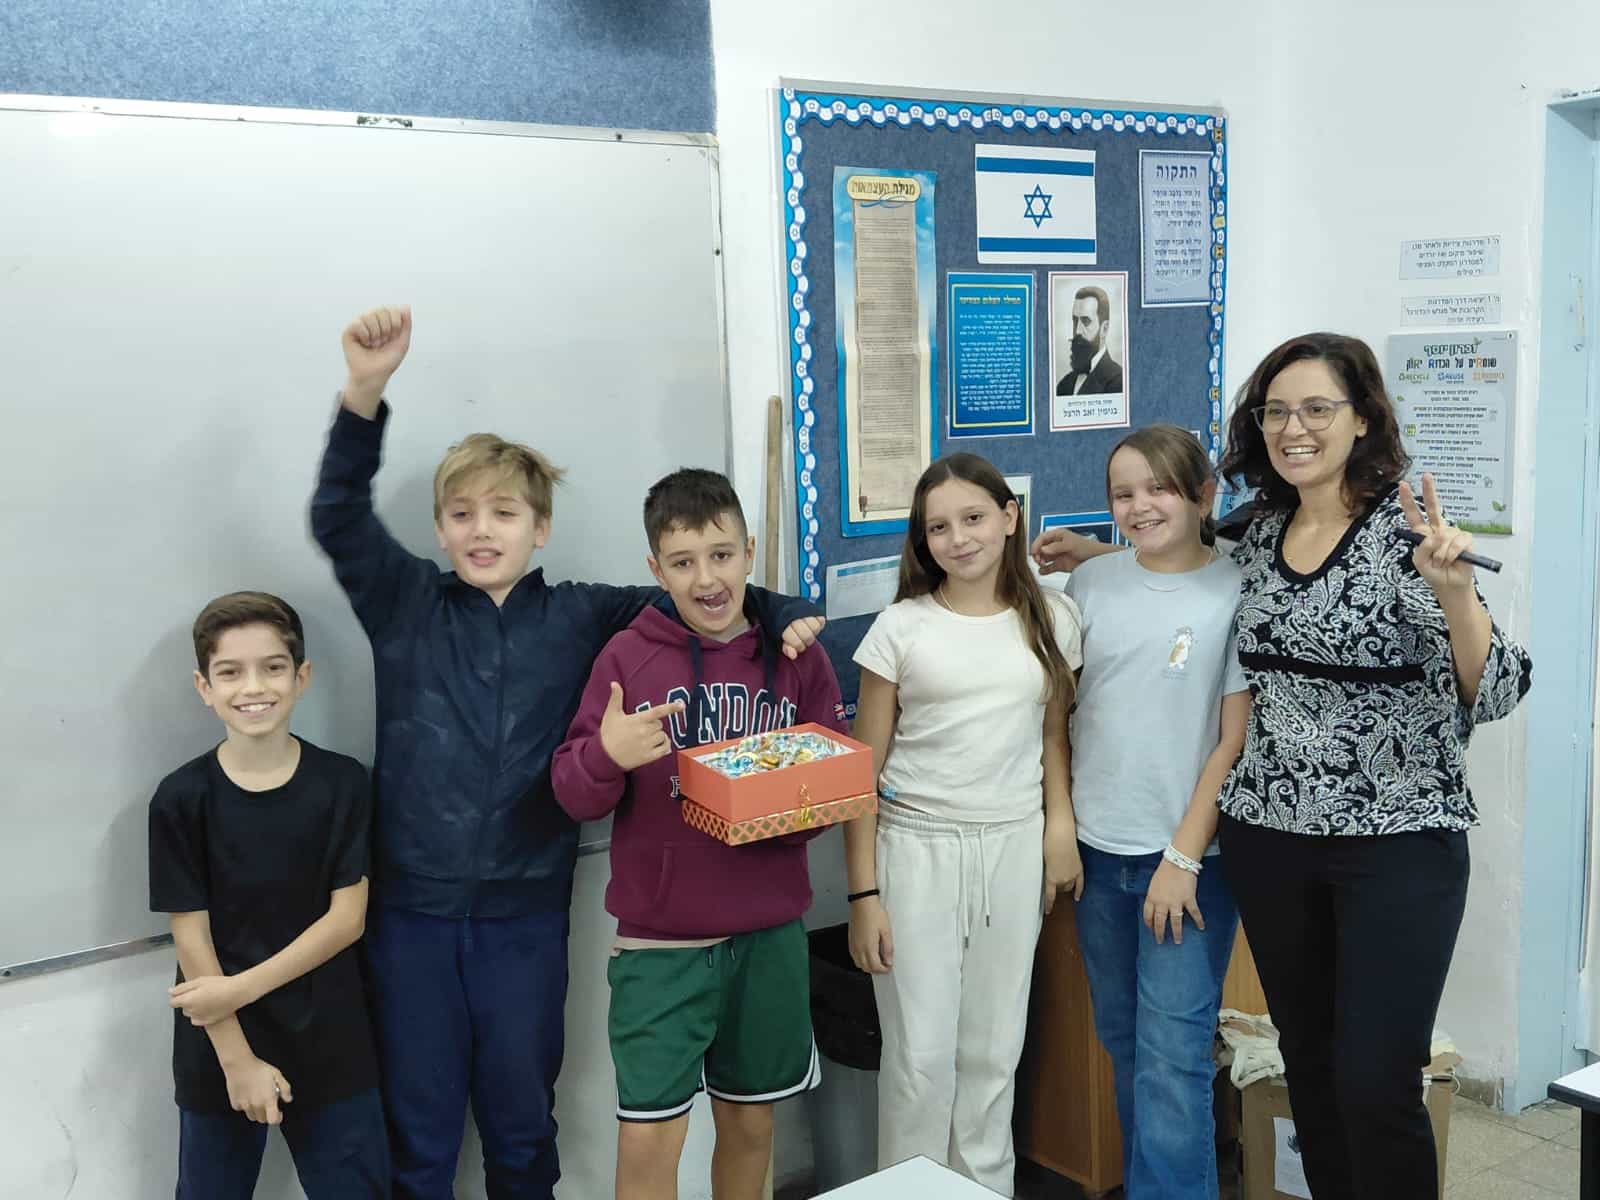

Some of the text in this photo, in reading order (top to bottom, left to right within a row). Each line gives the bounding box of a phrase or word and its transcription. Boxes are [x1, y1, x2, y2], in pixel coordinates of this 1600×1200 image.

[1156, 164, 1197, 182] התקוה
[851, 180, 916, 195] מגילת העצמאות
[1454, 356, 1464, 369] על
[636, 683, 797, 749] ONDON
